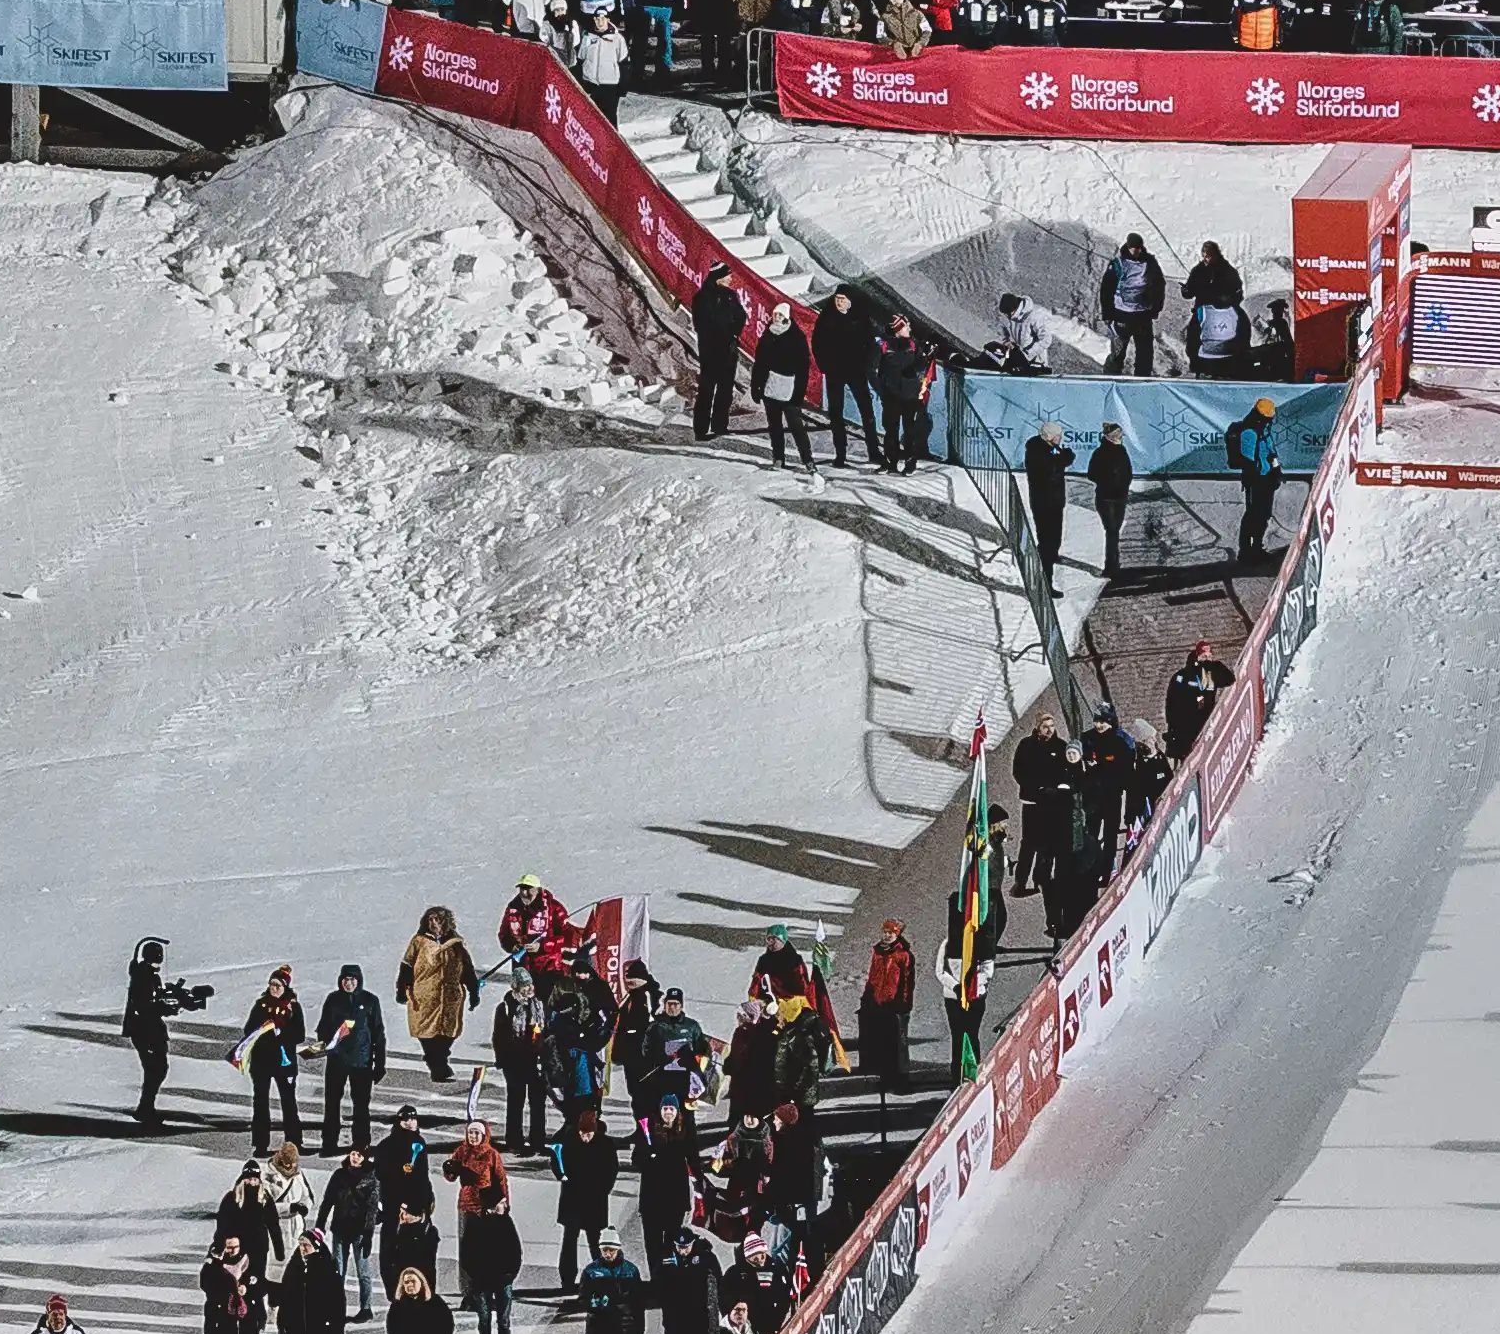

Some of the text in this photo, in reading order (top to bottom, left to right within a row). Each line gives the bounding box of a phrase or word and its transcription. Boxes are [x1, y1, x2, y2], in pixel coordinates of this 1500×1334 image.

[52, 48, 110, 62] SKIFEST
[157, 51, 215, 64] SKIFEST
[424, 43, 476, 70] Norges
[422, 61, 498, 94] Skiforbund
[853, 67, 914, 85] Norges
[1071, 74, 1138, 94] Norges
[852, 84, 948, 105] Skiforbund
[1297, 81, 1365, 100] Norges
[1070, 93, 1173, 113] Skiforbund
[1296, 99, 1399, 118] Skiforbund
[1296, 256, 1367, 272] VIESSMANN
[1296, 288, 1367, 305] VIESSMANN
[1364, 466, 1447, 484] VIESSMANN
